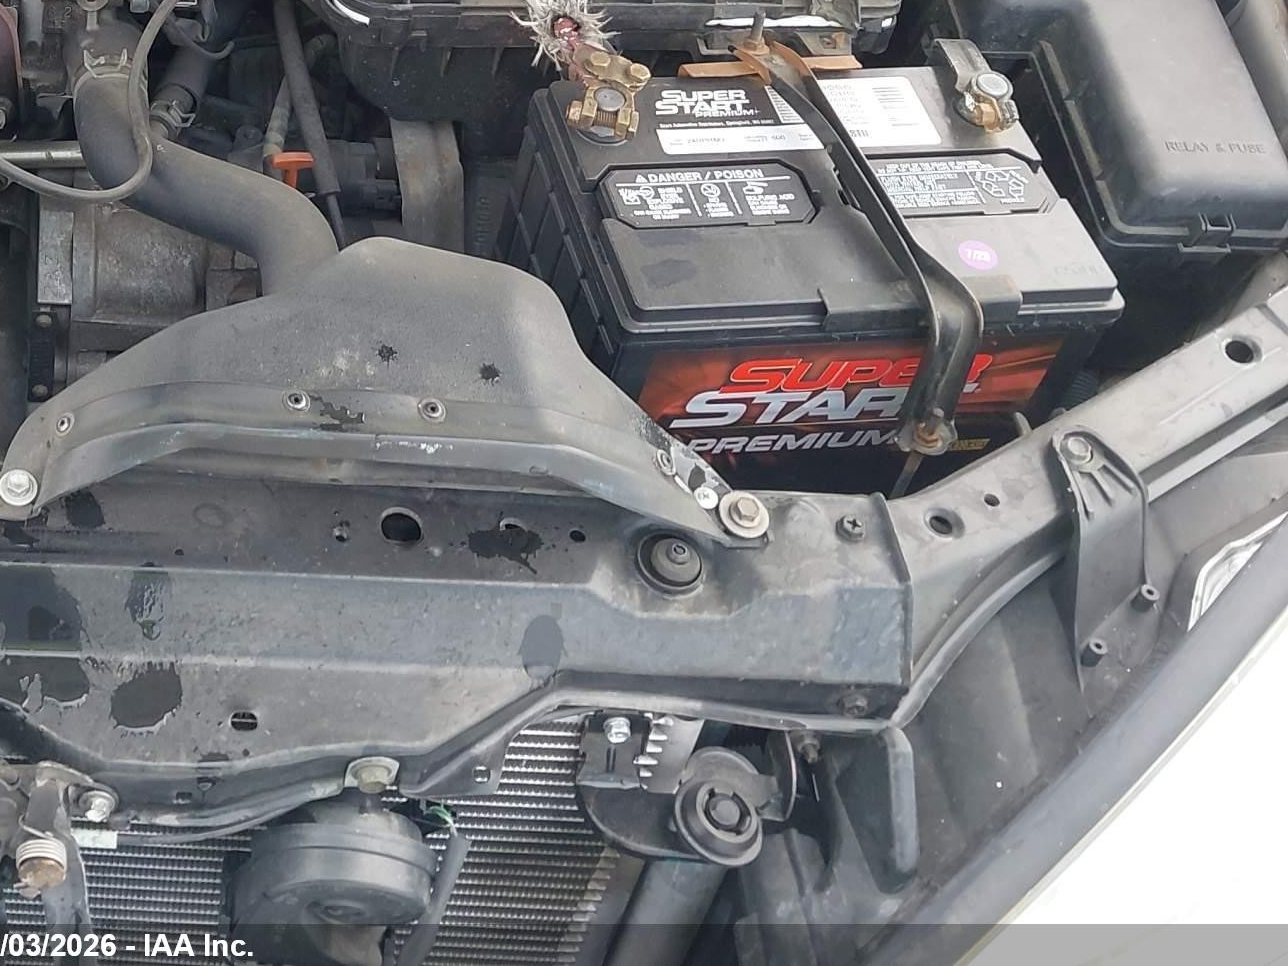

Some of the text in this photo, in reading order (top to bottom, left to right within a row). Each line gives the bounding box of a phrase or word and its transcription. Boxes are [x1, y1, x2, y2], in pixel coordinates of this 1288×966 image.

[661, 89, 746, 102] SUPER
[655, 99, 750, 116] START
[1164, 141, 1209, 153] RELAY
[1228, 143, 1268, 154] FUSE
[647, 171, 703, 183] DANGER
[713, 168, 765, 180] POISON
